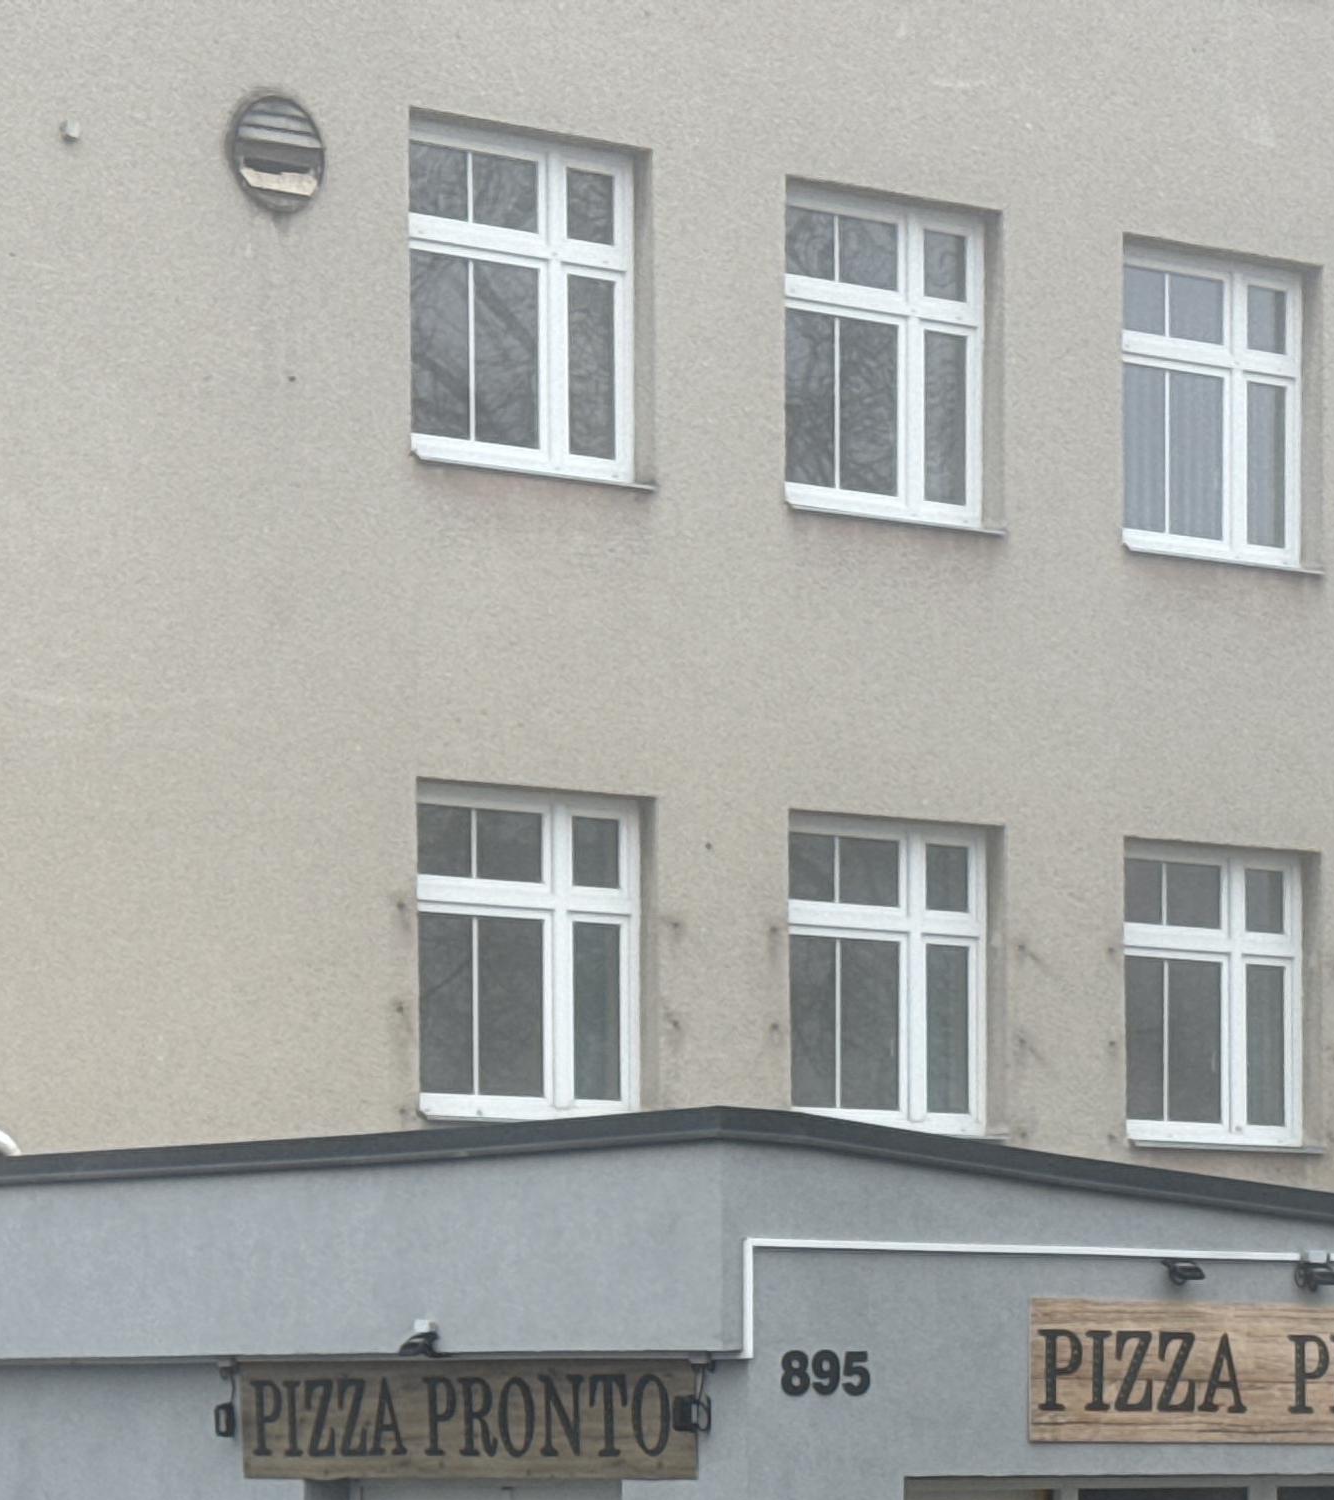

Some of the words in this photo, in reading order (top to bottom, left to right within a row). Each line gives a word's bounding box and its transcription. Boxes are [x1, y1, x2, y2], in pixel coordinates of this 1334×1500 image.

[780, 1349, 871, 1397] 895
[1037, 1328, 1247, 1414] PIZZA
[250, 1376, 407, 1458] PIZZA
[421, 1373, 670, 1458] PRONTO
